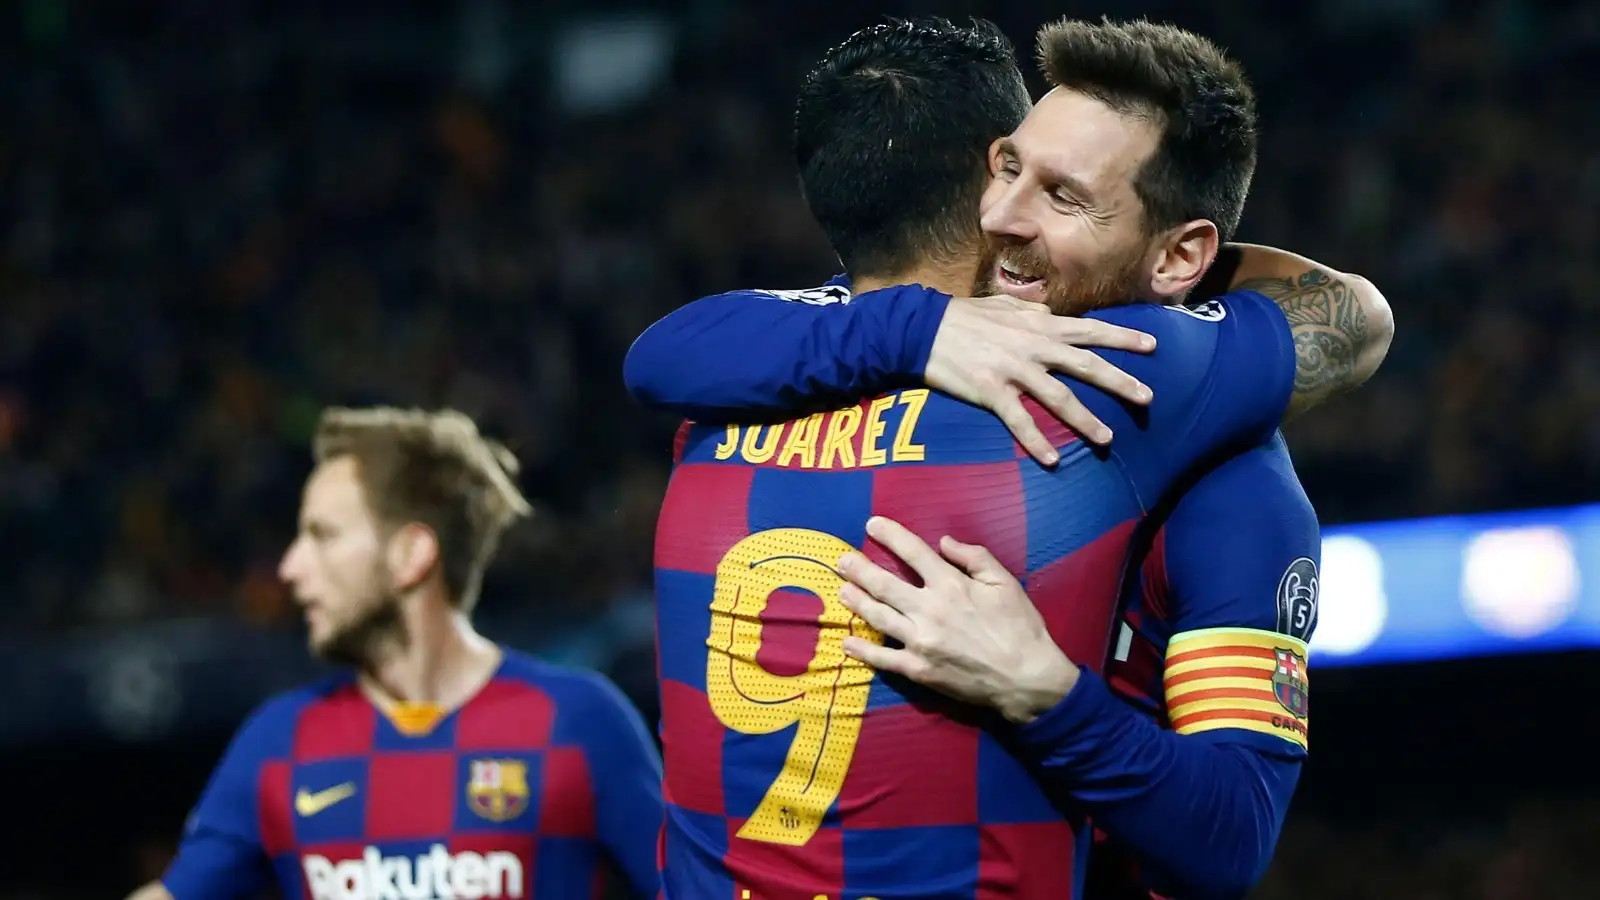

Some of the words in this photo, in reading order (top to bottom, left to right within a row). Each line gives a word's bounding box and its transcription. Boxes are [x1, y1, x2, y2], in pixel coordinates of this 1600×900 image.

[1295, 604, 1308, 629] 5
[705, 527, 885, 847] 9
[301, 843, 524, 900] Rakuten
